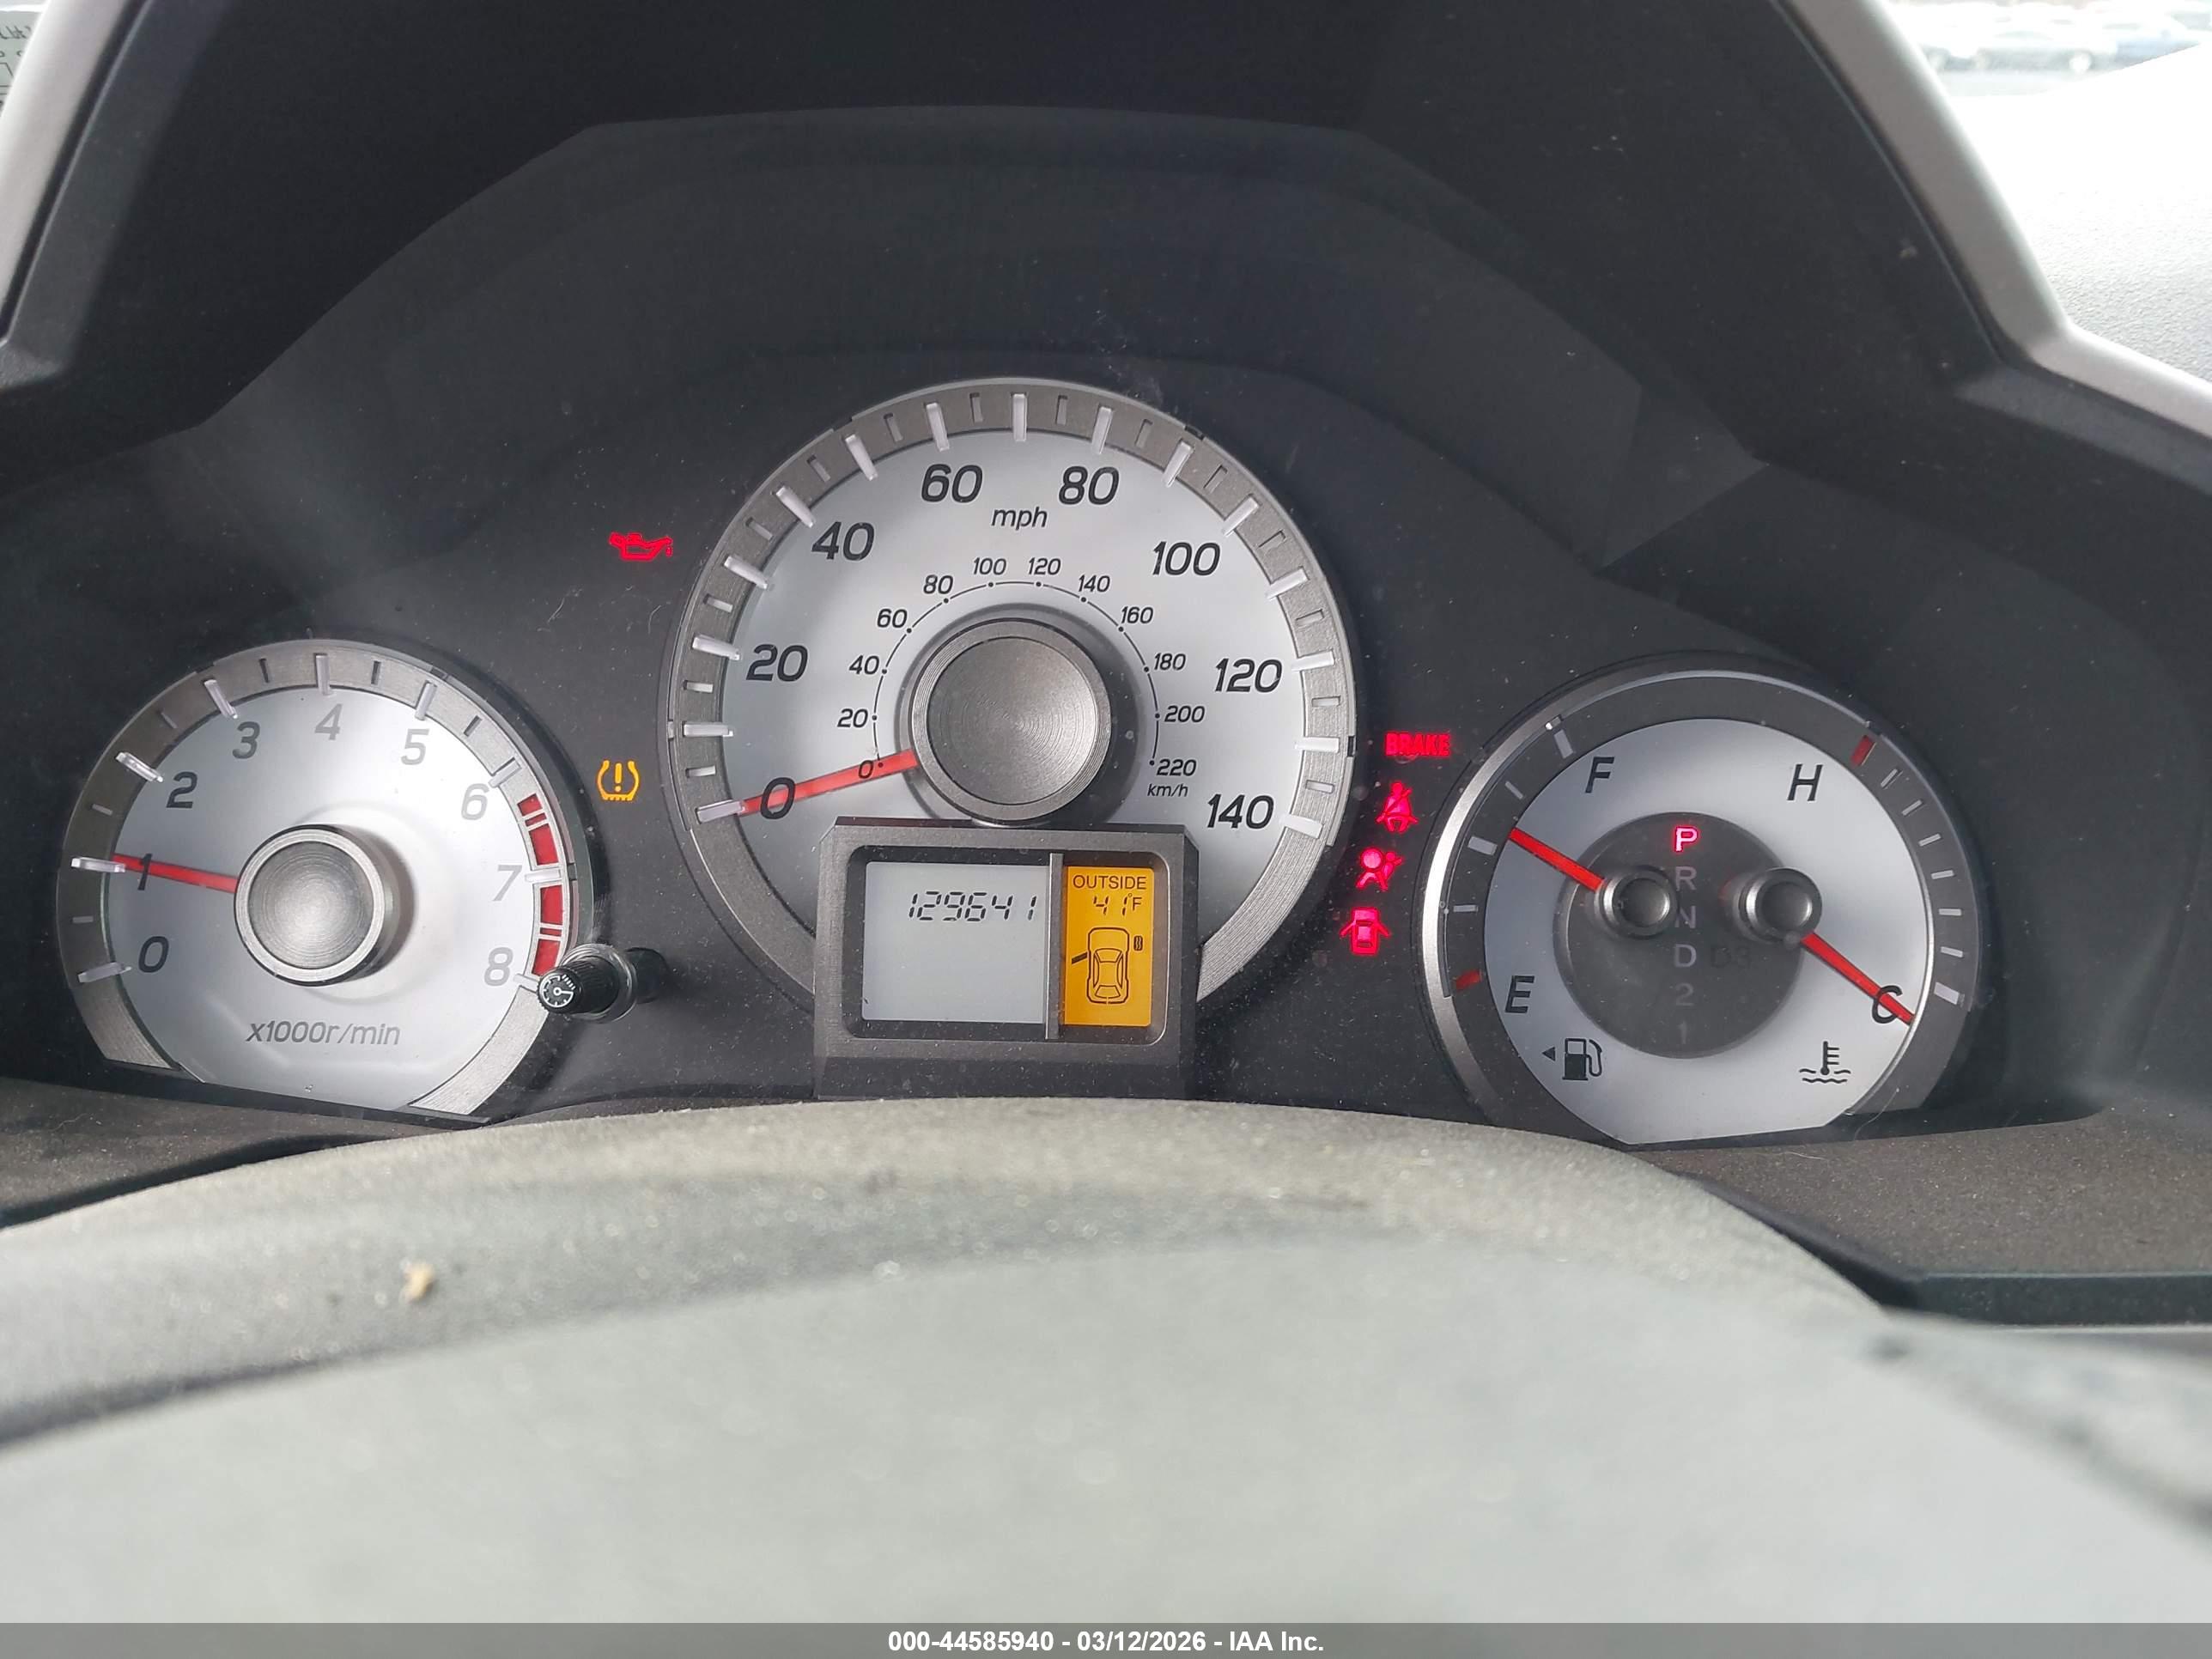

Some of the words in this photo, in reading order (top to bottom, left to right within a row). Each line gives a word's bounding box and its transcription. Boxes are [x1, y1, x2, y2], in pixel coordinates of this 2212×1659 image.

[921, 464, 983, 504] 60
[1058, 465, 1120, 506] 80
[992, 507, 1048, 530] mph
[811, 521, 874, 562] 40
[972, 556, 1007, 577] 100
[1027, 556, 1061, 577] 120
[1152, 541, 1220, 577] 100
[923, 574, 954, 596] 80
[1078, 574, 1111, 594] 140
[877, 609, 908, 629] 60
[1121, 605, 1153, 625] 160
[746, 644, 808, 683] 20
[848, 655, 880, 676] 40
[1154, 652, 1187, 672] 180
[1215, 659, 1282, 694] 120
[315, 704, 340, 741] 4
[836, 708, 868, 730] 20
[1164, 705, 1205, 723] 200
[233, 722, 259, 759] 3
[401, 729, 429, 764] 5
[1385, 732, 1452, 757] BRAKE
[858, 760, 874, 781] 0
[1157, 759, 1197, 777] 220
[1585, 756, 1614, 794] F
[1787, 763, 1824, 801] H
[167, 772, 197, 809] 2
[461, 783, 488, 820] 6
[759, 777, 796, 820] 0
[1147, 783, 1188, 799] km/h
[1207, 794, 1274, 830] 140
[1675, 826, 1698, 853] P
[137, 854, 153, 891] 1
[493, 866, 522, 902] 7
[1073, 874, 1146, 890] OUTSIDE
[1675, 866, 1697, 892] R
[908, 890, 1036, 921] 129641
[1676, 907, 1697, 930] N
[138, 936, 169, 973] 0
[485, 947, 514, 985] 8
[1674, 945, 1697, 969] D
[1505, 975, 1534, 1014] E
[1675, 983, 1695, 1006] 2
[1872, 986, 1903, 1023] C
[246, 1022, 400, 1045] x1000r/min
